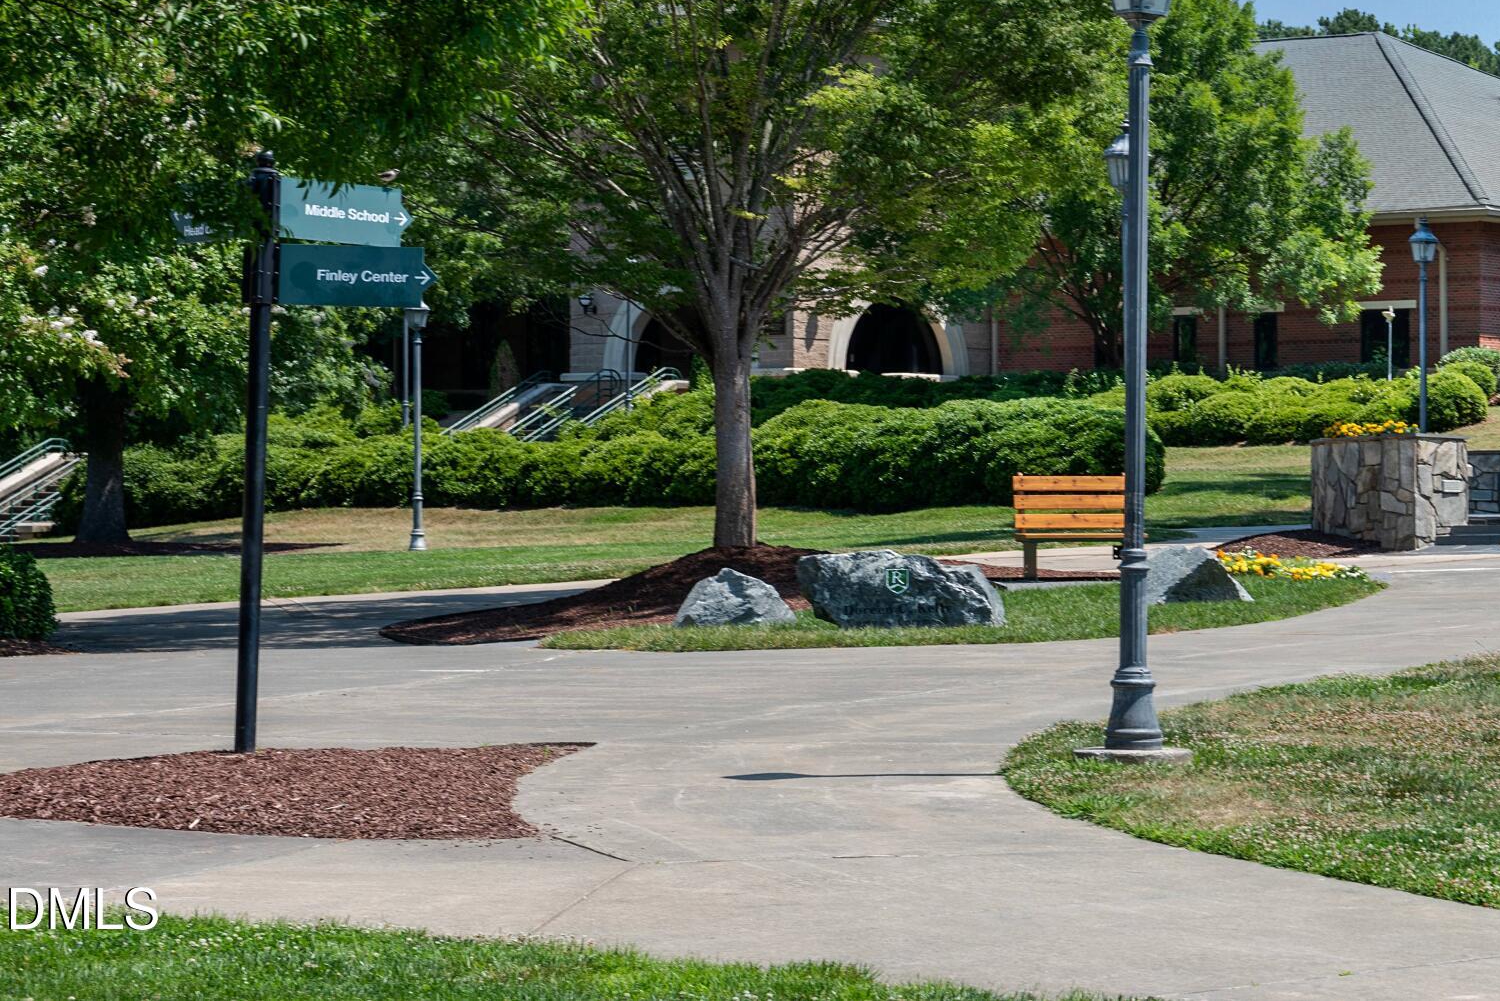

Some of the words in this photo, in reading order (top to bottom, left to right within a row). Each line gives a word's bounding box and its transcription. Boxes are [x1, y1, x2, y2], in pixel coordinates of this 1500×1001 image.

[304, 203, 346, 220] Middle
[347, 207, 390, 224] School
[316, 268, 359, 285] Finley
[361, 269, 409, 284] Center
[891, 570, 905, 585] R
